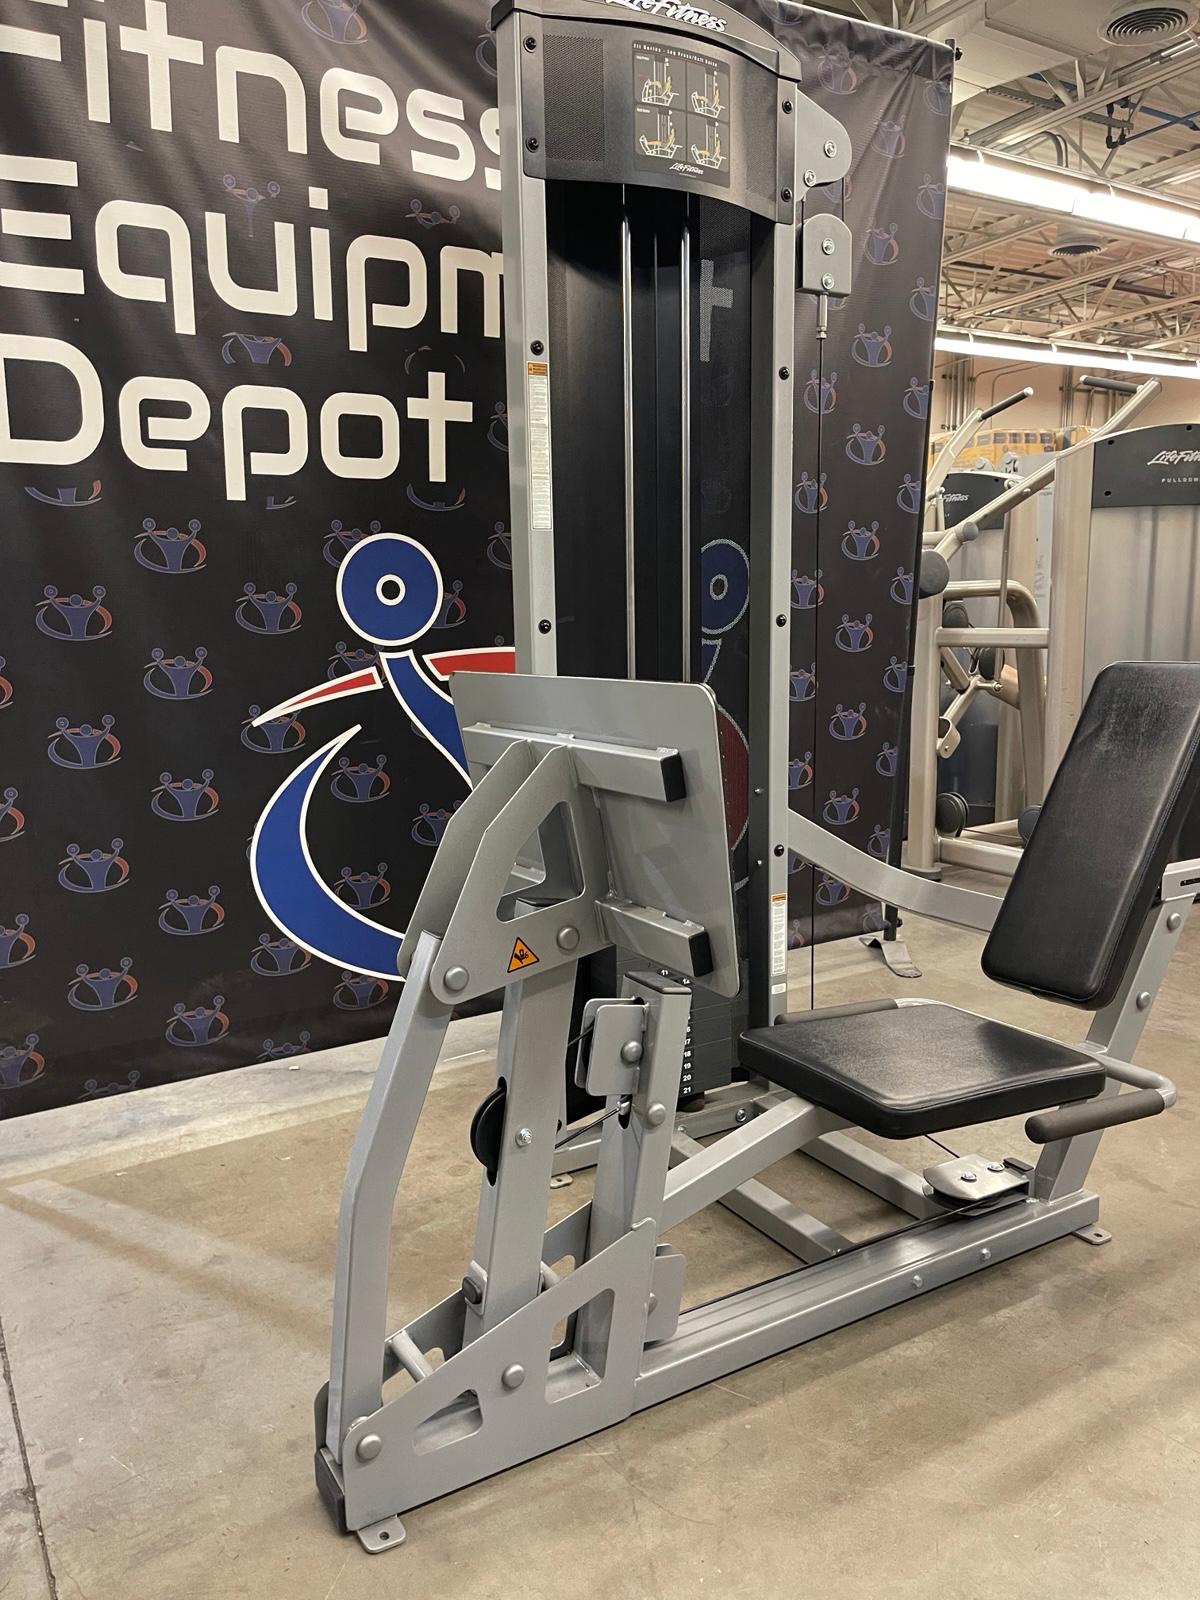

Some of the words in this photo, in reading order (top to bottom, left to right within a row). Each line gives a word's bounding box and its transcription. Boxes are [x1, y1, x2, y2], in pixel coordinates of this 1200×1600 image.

[0, 0, 502, 190] itnes
[0, 333, 474, 501] Depot
[682, 1073, 692, 1082] 20
[682, 1086, 692, 1094] 21
